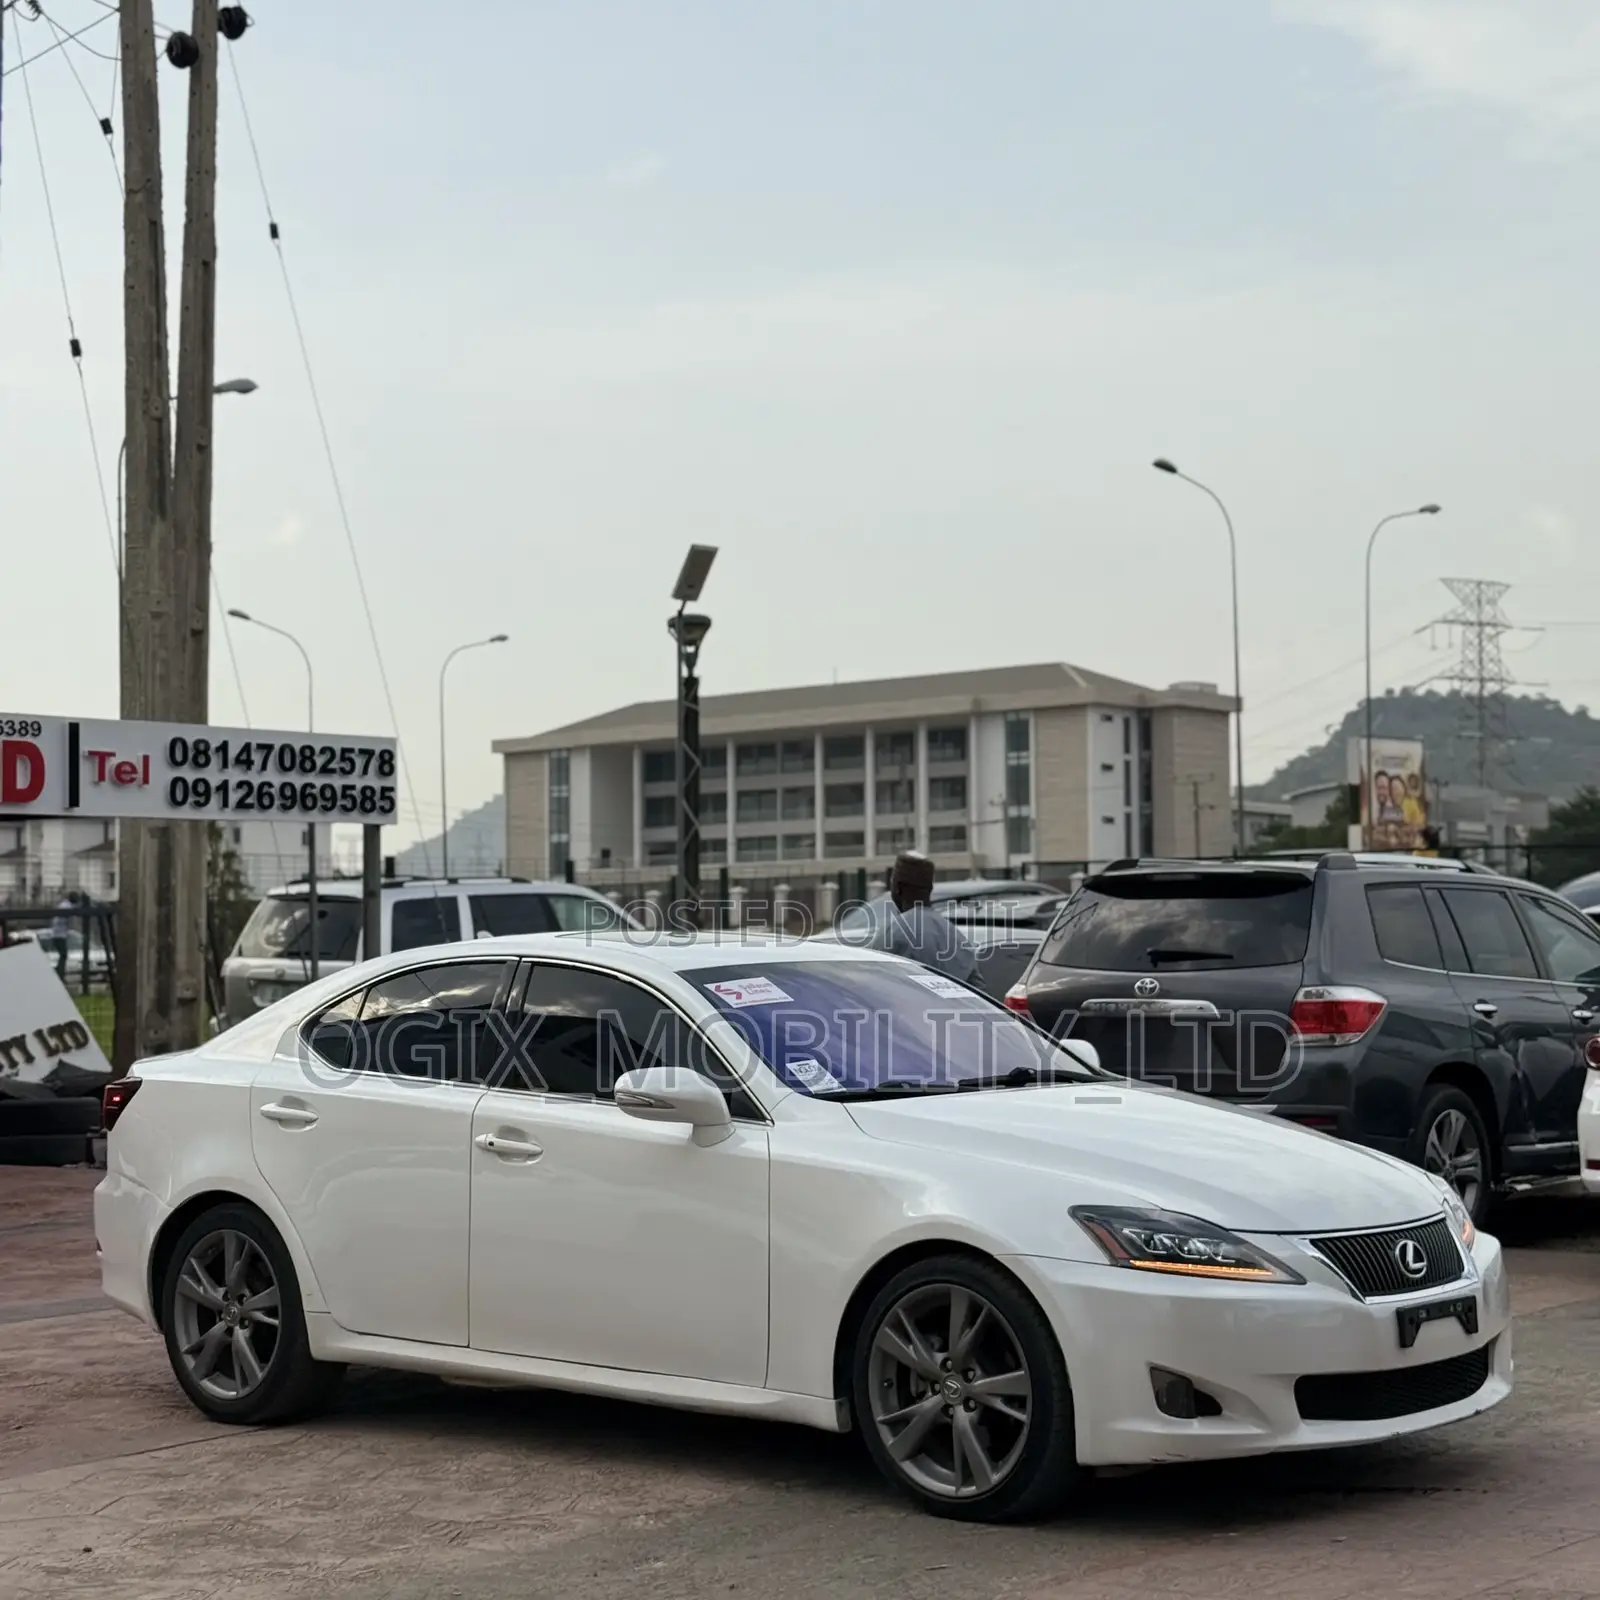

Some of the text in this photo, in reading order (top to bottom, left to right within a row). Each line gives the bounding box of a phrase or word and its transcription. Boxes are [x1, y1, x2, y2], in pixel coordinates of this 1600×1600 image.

[86, 749, 151, 786] Tel
[168, 736, 396, 777] 08147082578
[168, 776, 397, 815] 09126969585
[32, 1020, 90, 1058] LTD
